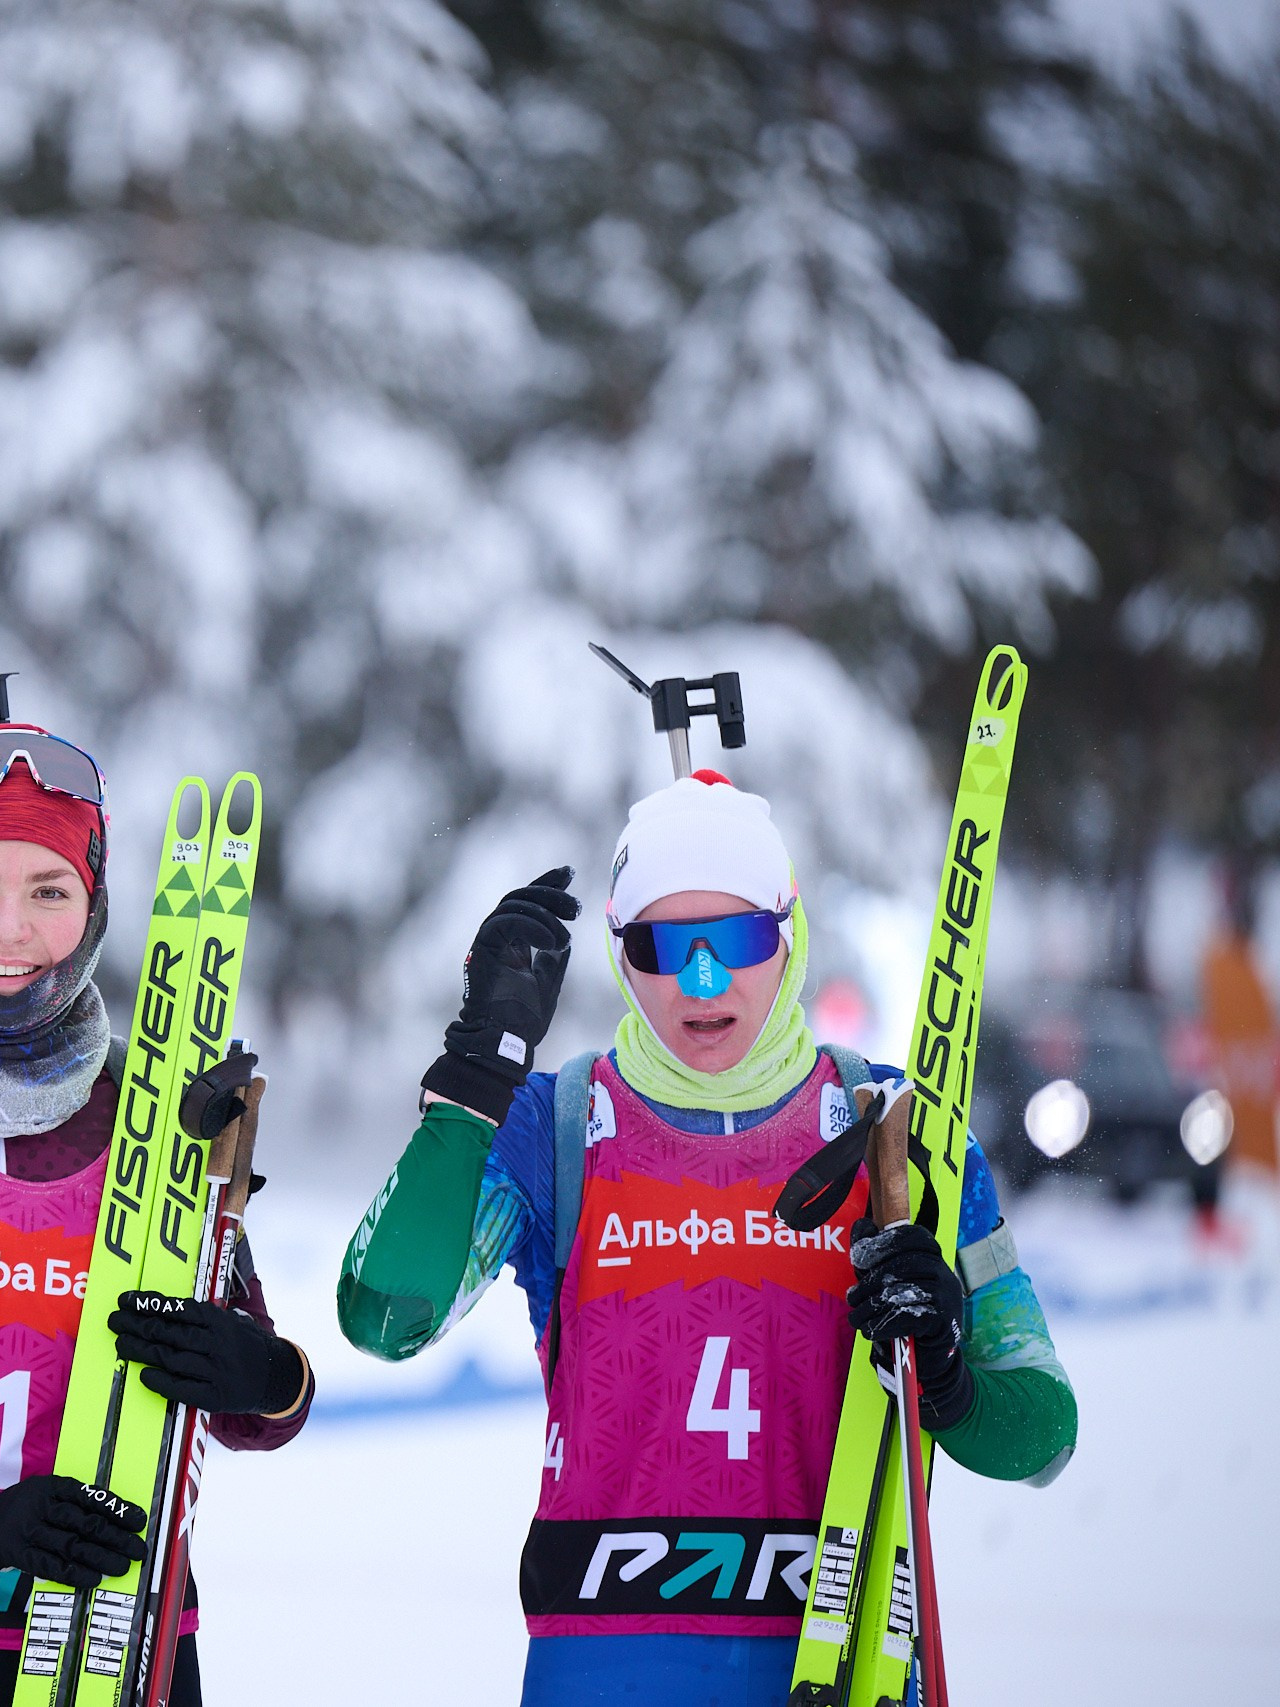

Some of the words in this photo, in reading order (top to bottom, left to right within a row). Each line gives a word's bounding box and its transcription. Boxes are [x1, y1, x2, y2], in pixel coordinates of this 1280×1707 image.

[908, 818, 991, 1162] FISCHER
[104, 940, 184, 1265] FISCHER
[159, 936, 236, 1264] FISHER
[598, 1209, 735, 1256] Альфа
[44, 1258, 90, 1300] Ба
[136, 1297, 185, 1313] MOAX
[686, 1336, 761, 1460] 4
[543, 1422, 564, 1482] 4
[80, 1483, 129, 1519] MOAX
[578, 1531, 818, 1602] PAR
